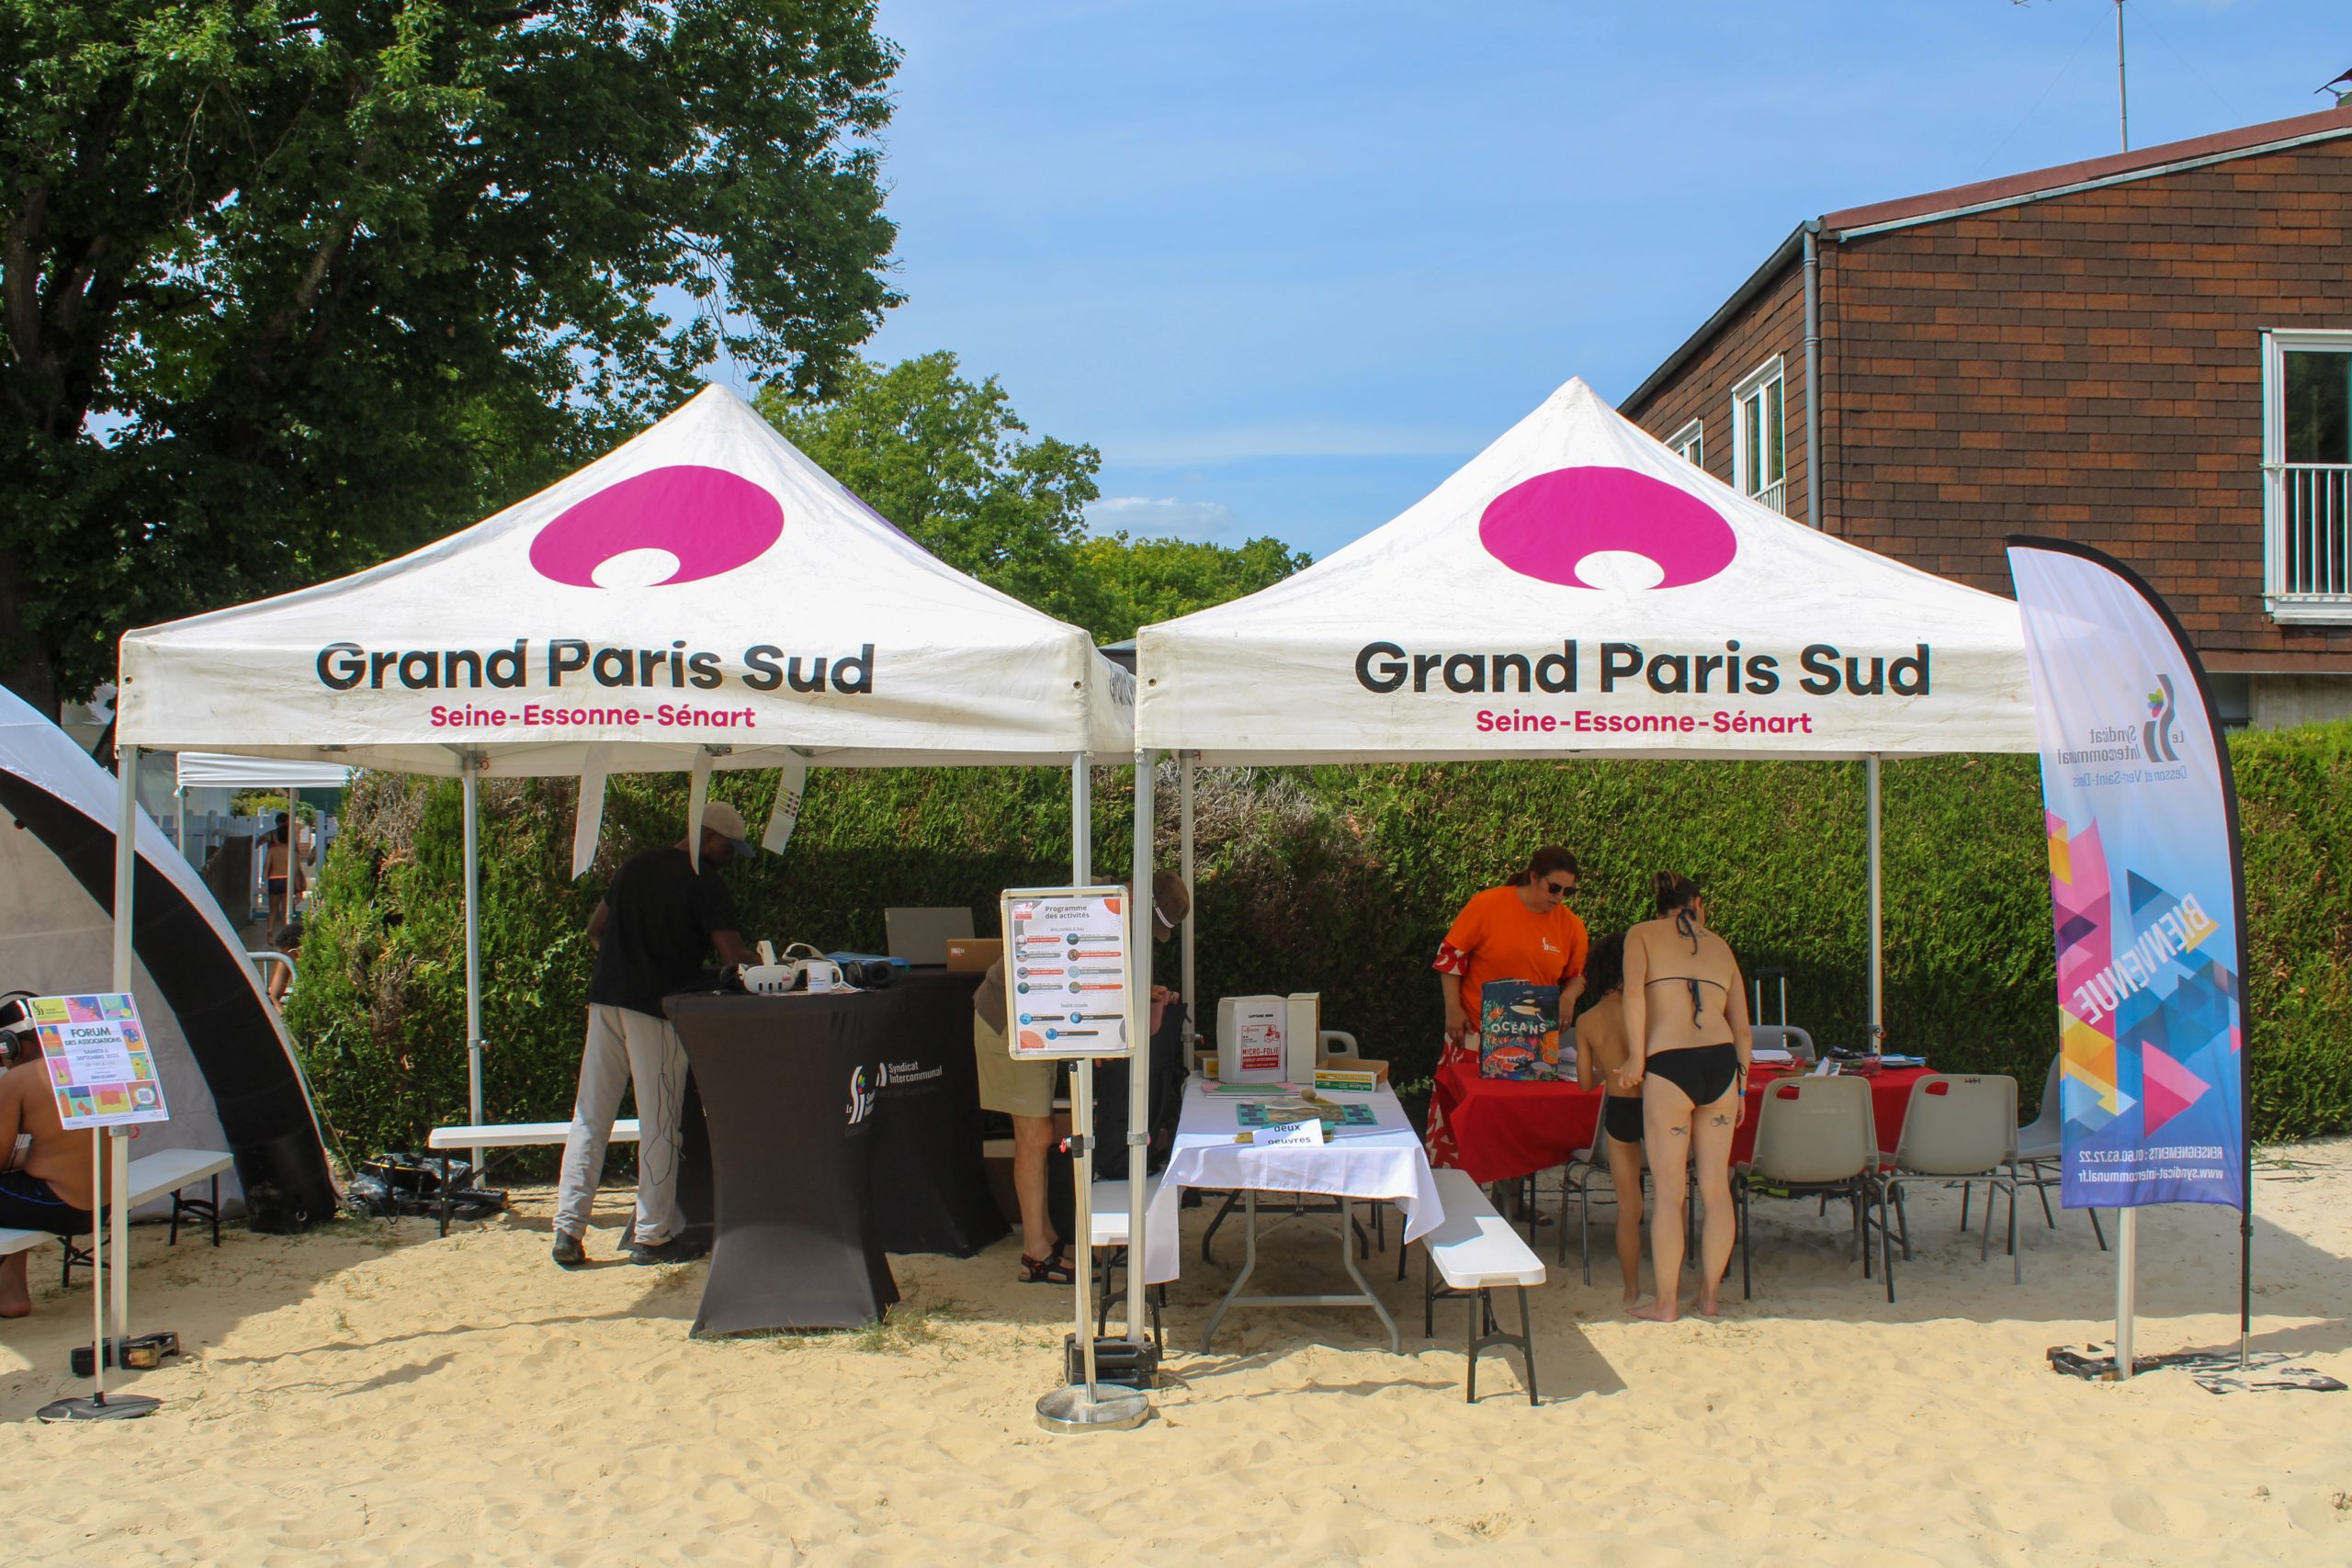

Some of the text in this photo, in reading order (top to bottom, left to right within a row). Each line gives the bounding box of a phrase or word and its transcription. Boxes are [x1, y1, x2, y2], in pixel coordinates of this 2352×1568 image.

[317, 638, 875, 694] Grand Paris Sud
[1355, 639, 1929, 695] Grand Paris Sud
[430, 704, 755, 728] Seine-Essonne-Sénart
[1476, 710, 1813, 734] Seine-Essonne-Sénart
[1045, 905, 1087, 914] Programme
[71, 1027, 111, 1038] FORUM
[1491, 1018, 1546, 1034] OCÉANS
[888, 1061, 919, 1075] Syndicat
[889, 1066, 943, 1084] Intercommunal
[1274, 1123, 1301, 1133] deux
[1267, 1136, 1311, 1145] oeuvres
